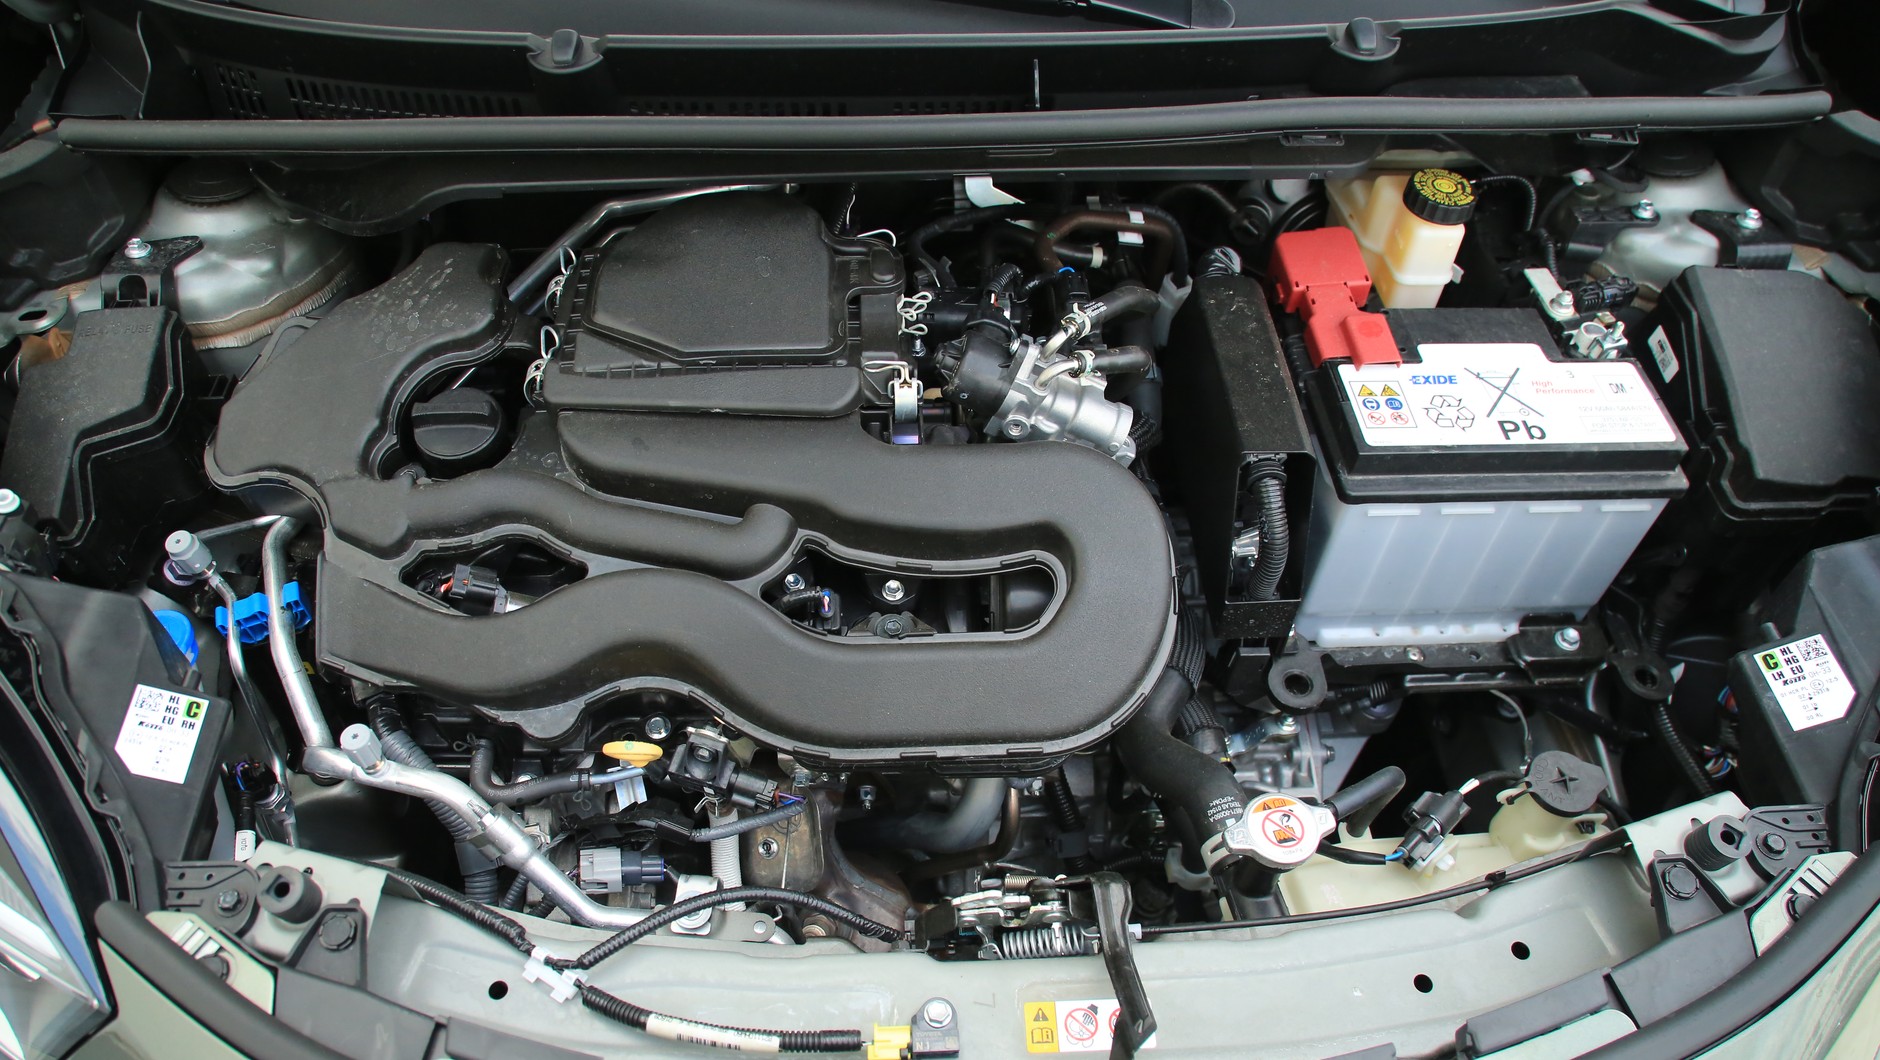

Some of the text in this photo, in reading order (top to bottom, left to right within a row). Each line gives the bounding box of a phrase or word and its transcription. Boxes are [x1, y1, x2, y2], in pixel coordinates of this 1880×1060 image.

[1411, 374, 1458, 385] EXIDE
[1531, 380, 1553, 388] High
[1496, 420, 1547, 440] Pb
[1779, 646, 1794, 656] HL
[1761, 653, 1779, 670] C
[1784, 655, 1799, 666] HG
[1771, 665, 1804, 681] LH EU
[164, 705, 180, 715] HG
[186, 701, 201, 718] C
[161, 715, 175, 726] EU
[181, 720, 196, 730] RH
